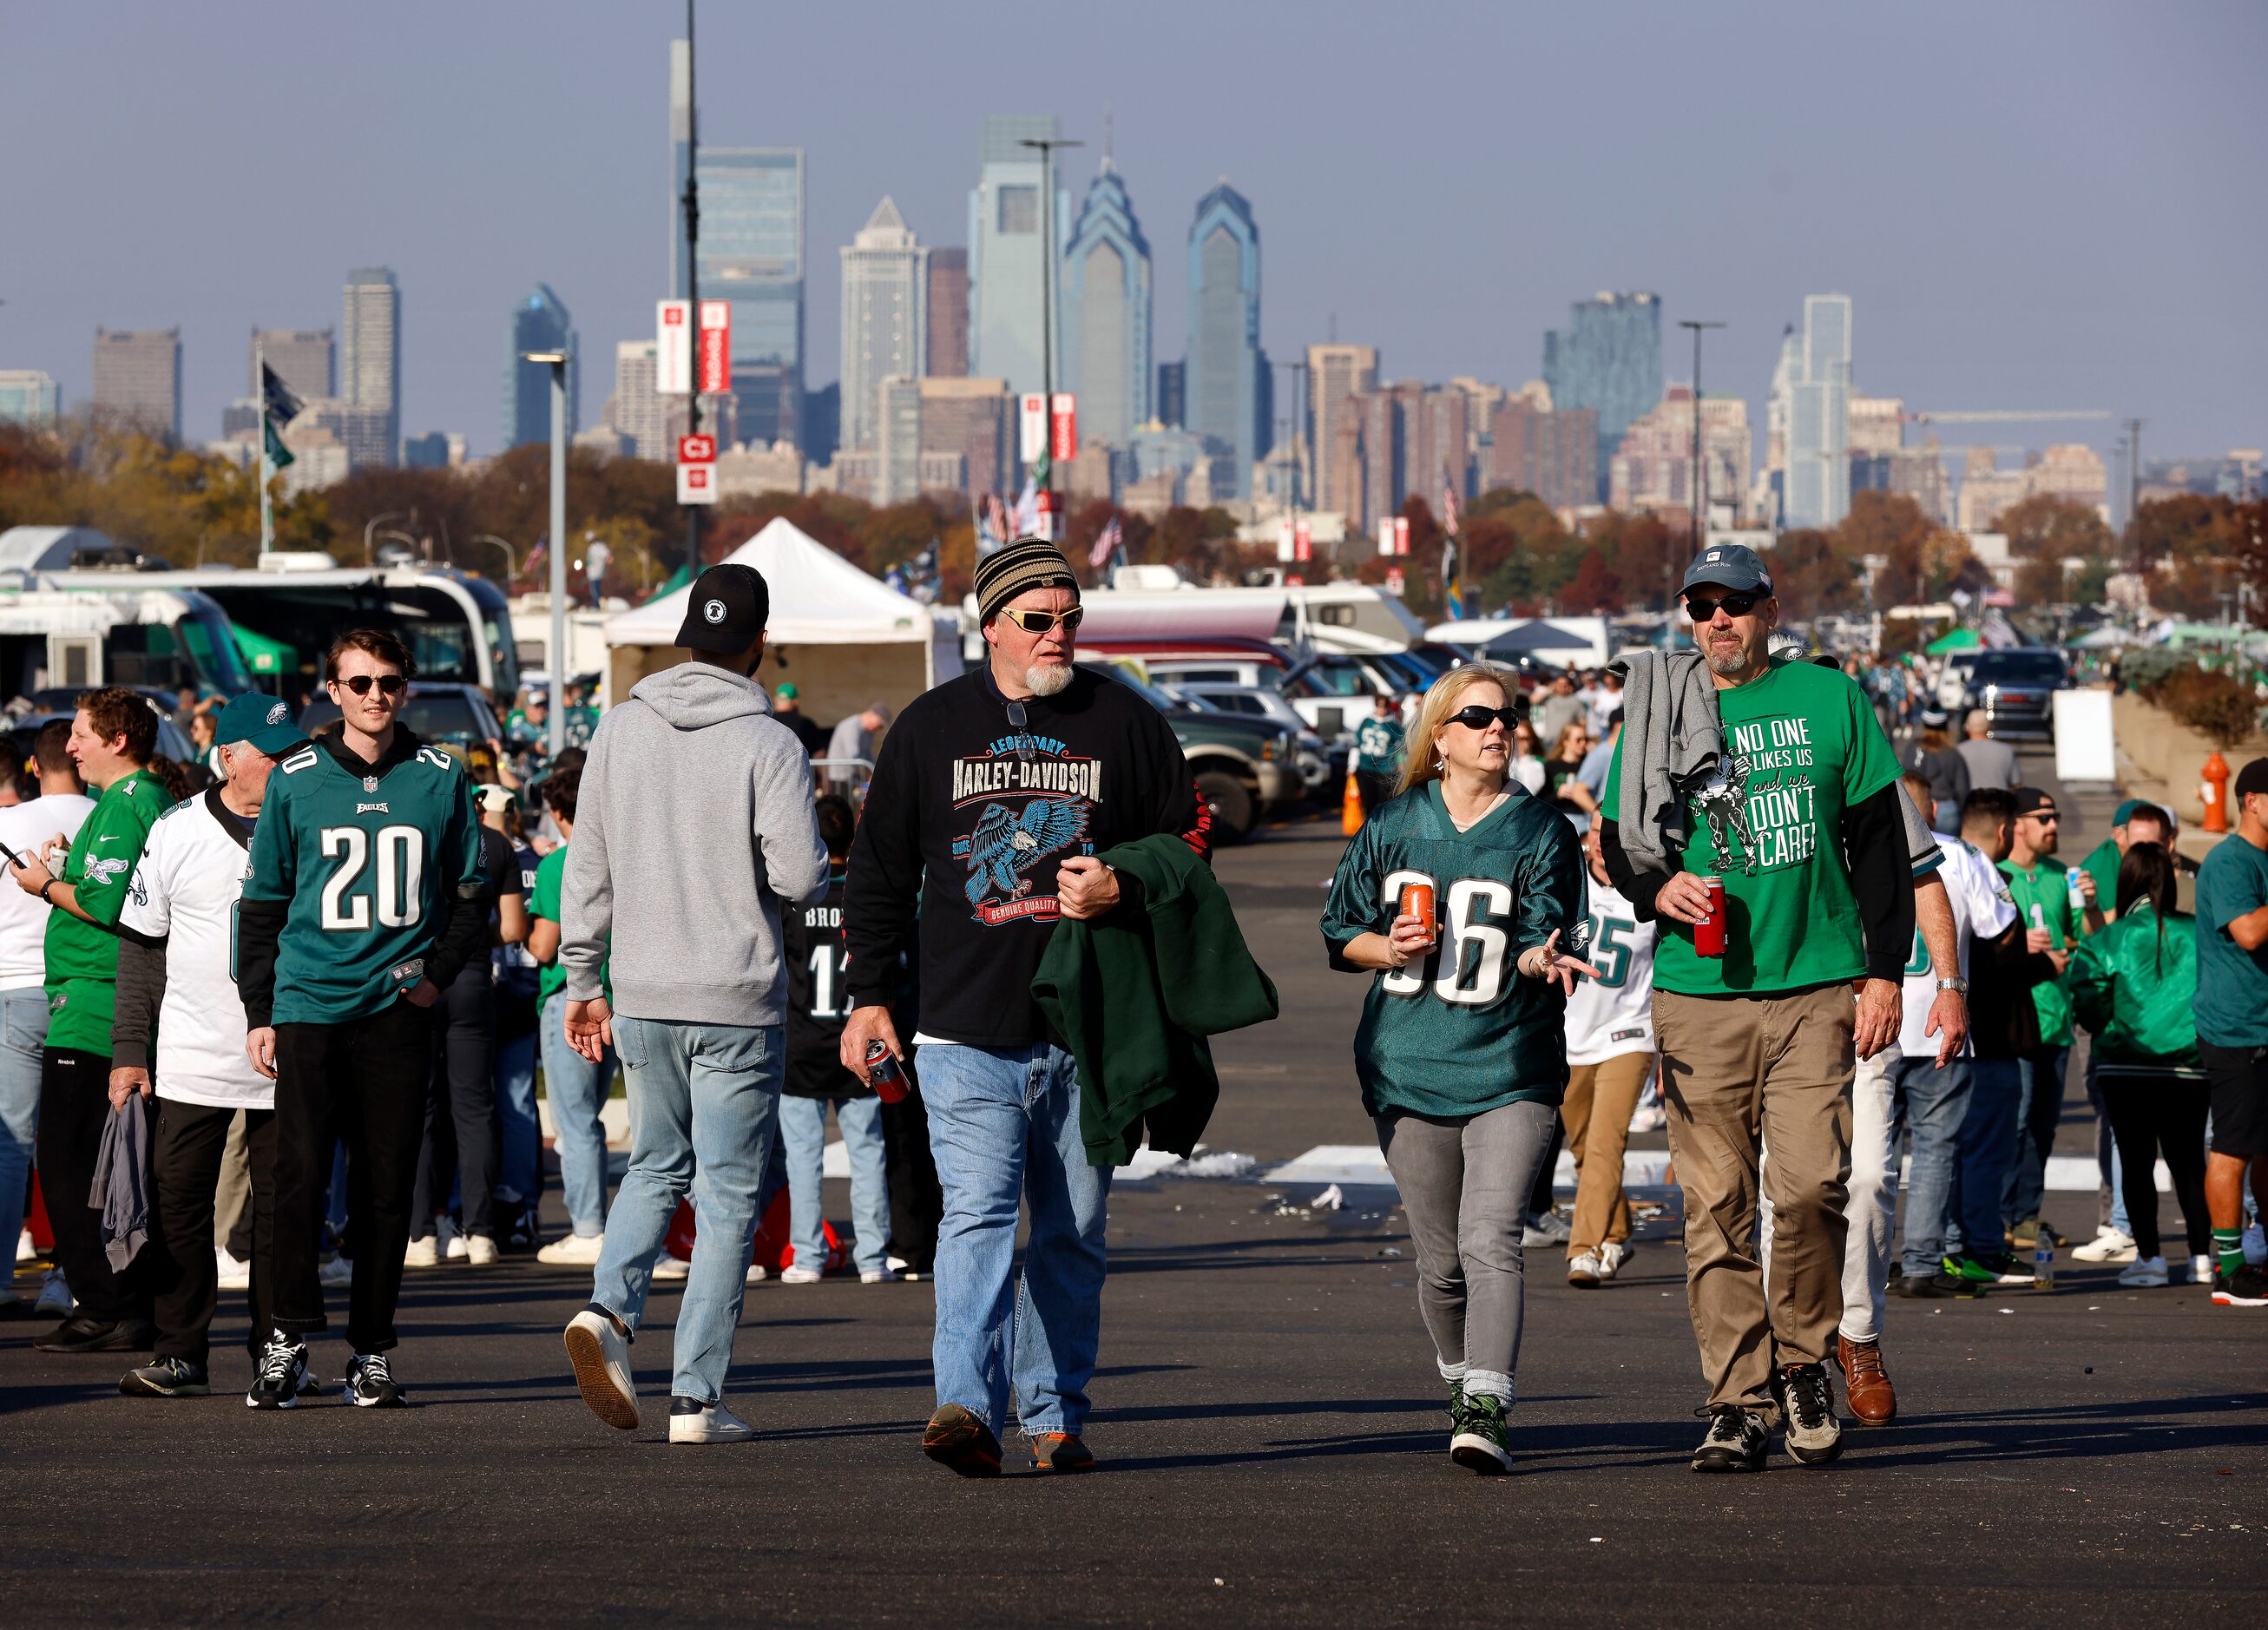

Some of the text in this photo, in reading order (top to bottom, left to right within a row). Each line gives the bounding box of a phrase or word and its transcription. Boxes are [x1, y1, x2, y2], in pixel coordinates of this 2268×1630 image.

[1734, 719, 1812, 755] NO ONE
[1752, 748, 1813, 772] LIKES US
[952, 759, 1102, 803] HARLEY-DAVIDSON
[1753, 772, 1810, 794] and we
[356, 802, 390, 815] EAGLES
[1750, 785, 1817, 832] DON'T
[952, 840, 1094, 856] SINCE 19
[1759, 822, 1817, 867] CARE!
[320, 825, 425, 932] 20
[805, 908, 845, 927] BRO
[991, 899, 1058, 921] GENUINE QUALITY
